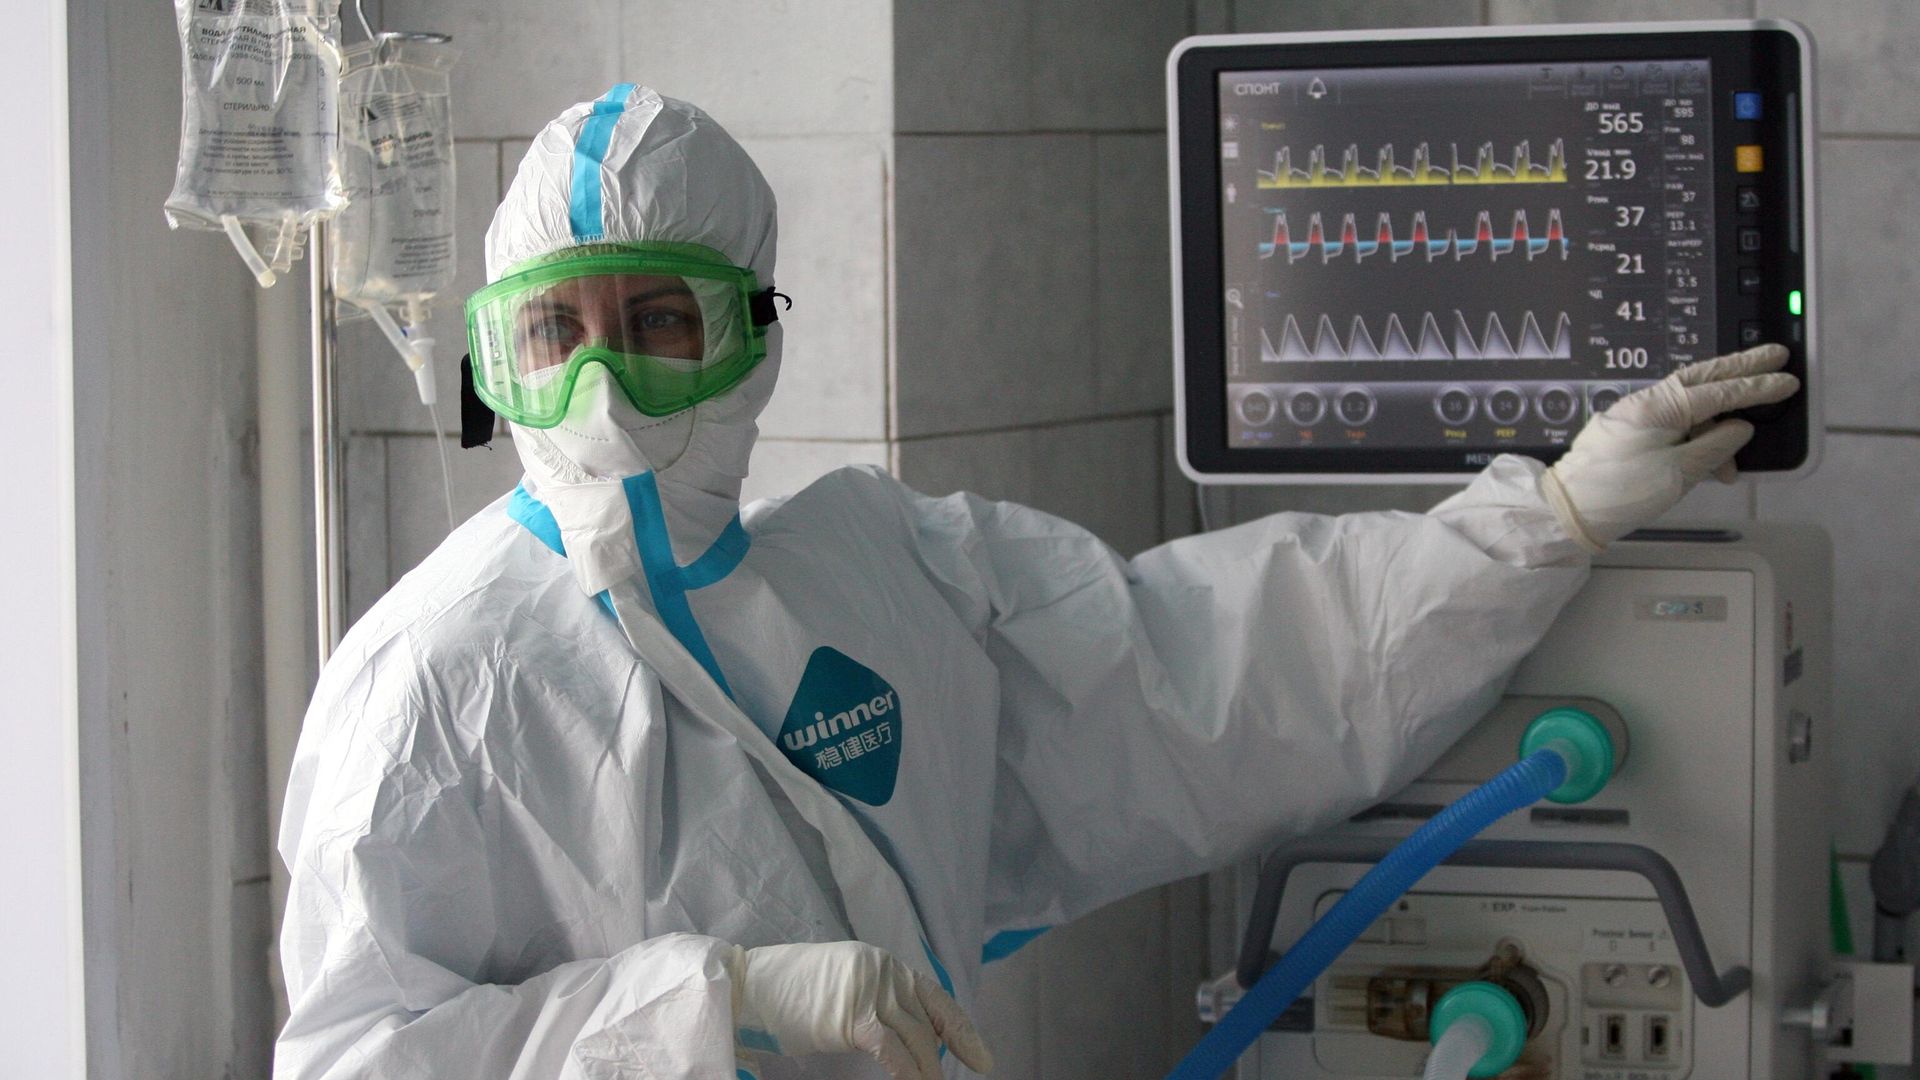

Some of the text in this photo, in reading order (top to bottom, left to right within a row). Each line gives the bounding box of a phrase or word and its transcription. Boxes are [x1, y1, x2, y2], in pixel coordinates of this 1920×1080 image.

[236, 77, 251, 86] 500
[1234, 82, 1280, 96] СПОНТ
[223, 102, 270, 112] СТЕРИЛЬНО
[1674, 107, 1694, 118] 595
[1599, 112, 1643, 134] 565
[1585, 159, 1636, 180] 21.9
[1682, 191, 1696, 202] 37
[1616, 206, 1645, 227] 37
[1670, 220, 1696, 231] 13.1
[1617, 253, 1645, 274] 21
[1617, 301, 1646, 321] 41
[1604, 347, 1648, 369] 100
[783, 690, 895, 751] winner
[815, 721, 893, 771] 稳健医疗
